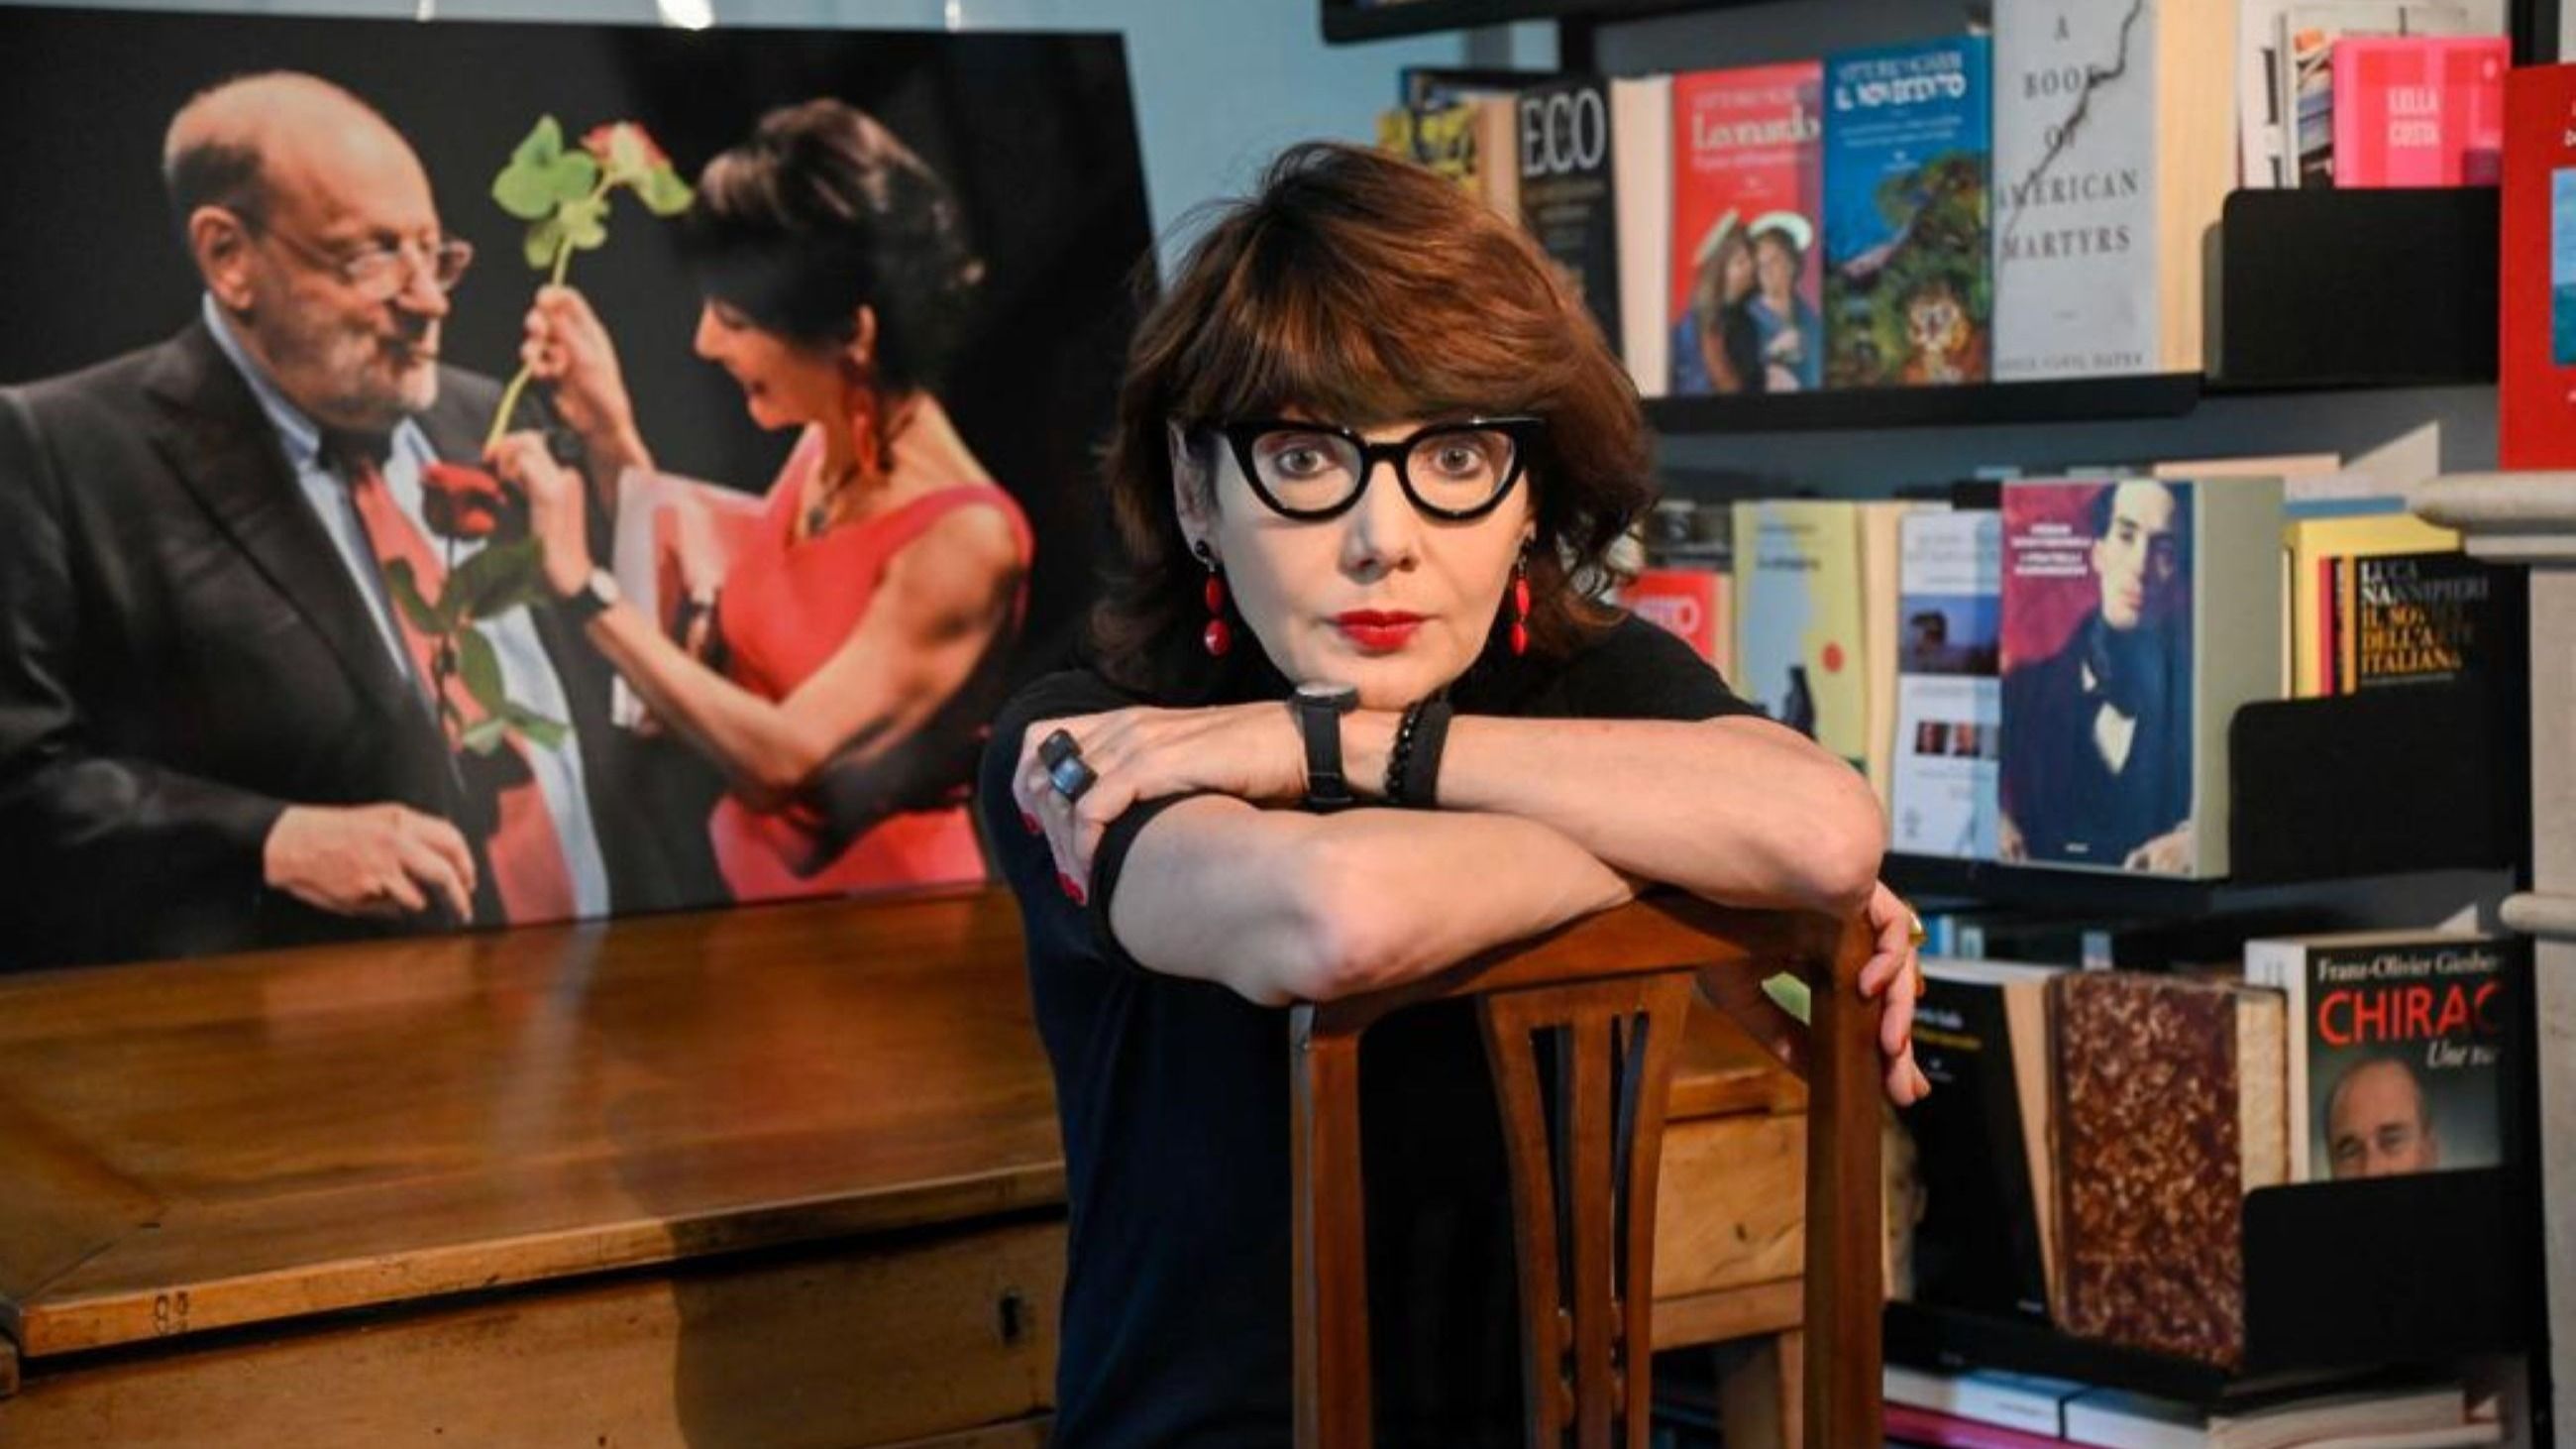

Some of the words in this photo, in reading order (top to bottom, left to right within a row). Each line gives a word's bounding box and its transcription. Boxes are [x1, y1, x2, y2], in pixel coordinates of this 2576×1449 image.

[2053, 15, 2071, 43] A
[1522, 88, 1605, 177] ECO
[1691, 103, 1820, 149] Leonardo
[2001, 224, 2131, 262] MARTYRS
[2362, 645, 2464, 675] ITALIANA
[2316, 978, 2502, 1049] CHIRAC
